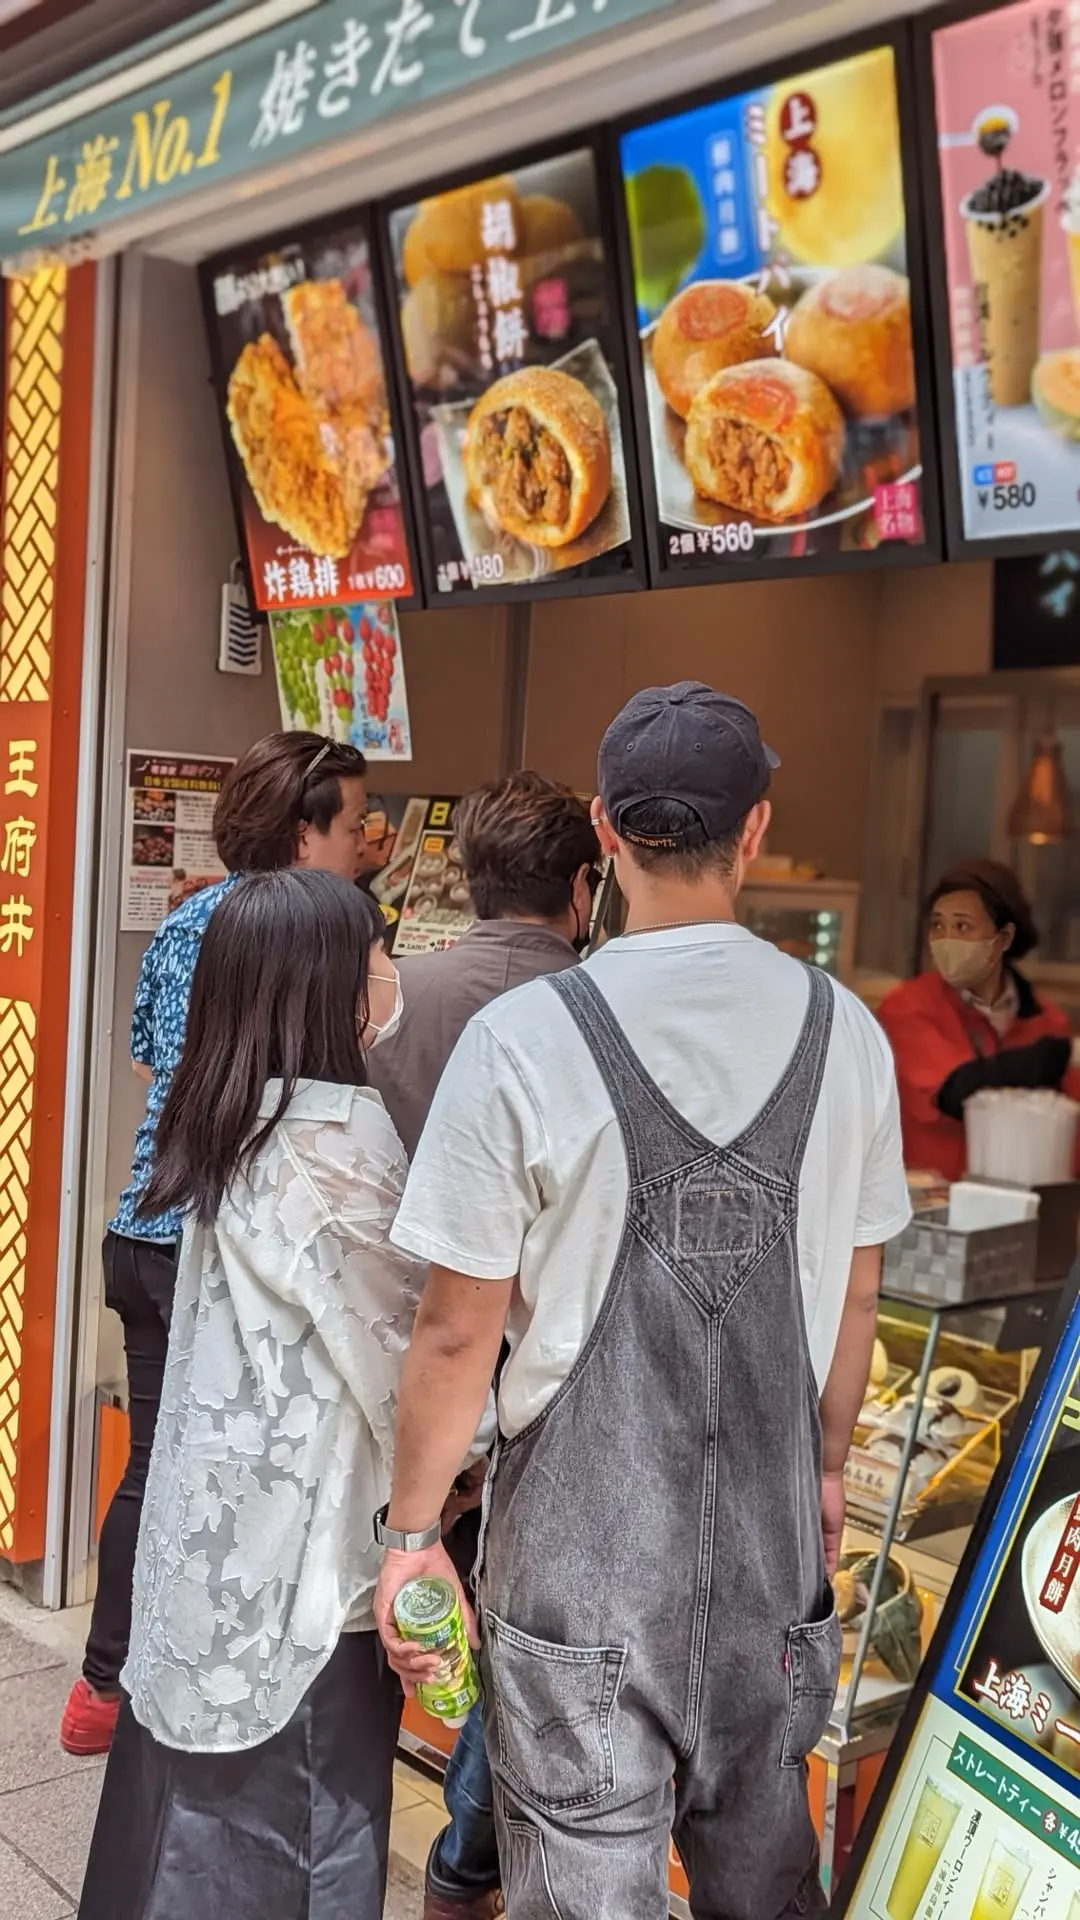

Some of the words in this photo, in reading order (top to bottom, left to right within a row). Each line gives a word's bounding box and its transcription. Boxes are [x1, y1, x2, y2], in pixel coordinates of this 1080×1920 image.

[784, 96, 816, 195] 上海
[746, 104, 790, 350] ミートパイ
[977, 481, 1036, 511] ¥580
[0, 739, 39, 957] 王府井
[1044, 1503, 1080, 1606] 肉月餅
[953, 1745, 1042, 1817] ストレートティー
[1032, 1867, 1057, 1920] シャンパ
